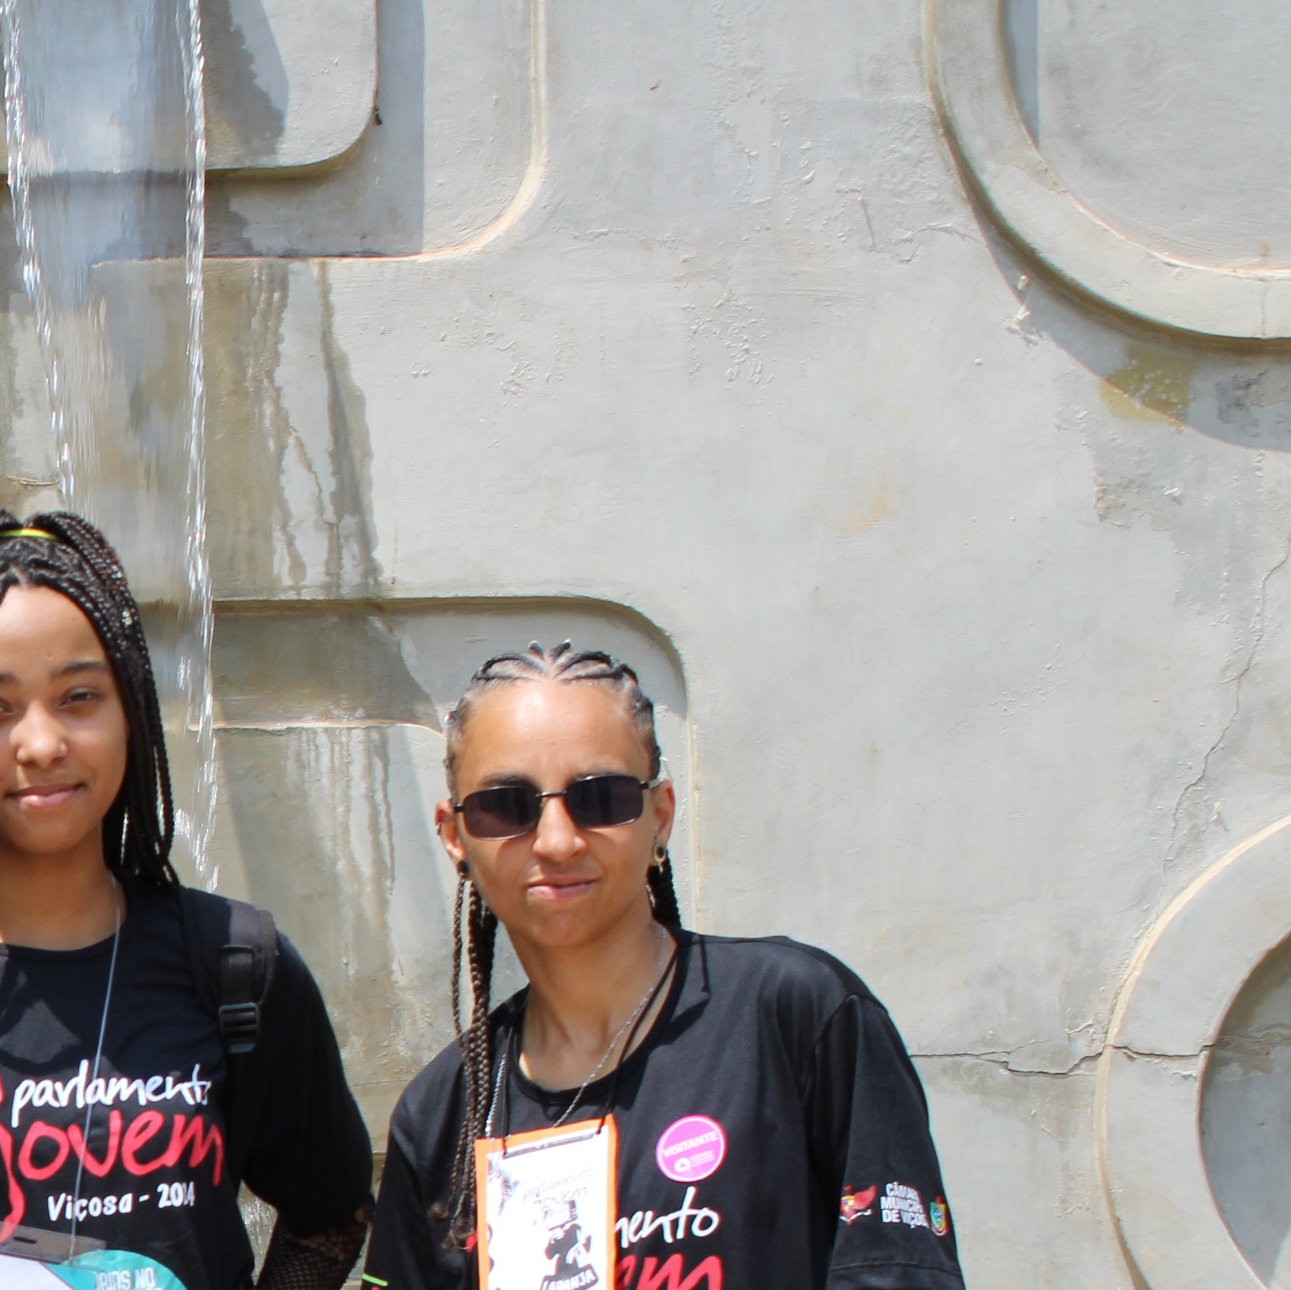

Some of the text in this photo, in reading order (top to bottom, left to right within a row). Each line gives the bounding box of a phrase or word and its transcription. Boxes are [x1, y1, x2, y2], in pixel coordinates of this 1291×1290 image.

[662, 1131, 718, 1158] VISITANTE
[47, 1193, 133, 1222] Viçosa
[882, 1209, 900, 1222] DE
[135, 1267, 155, 1289] NO
